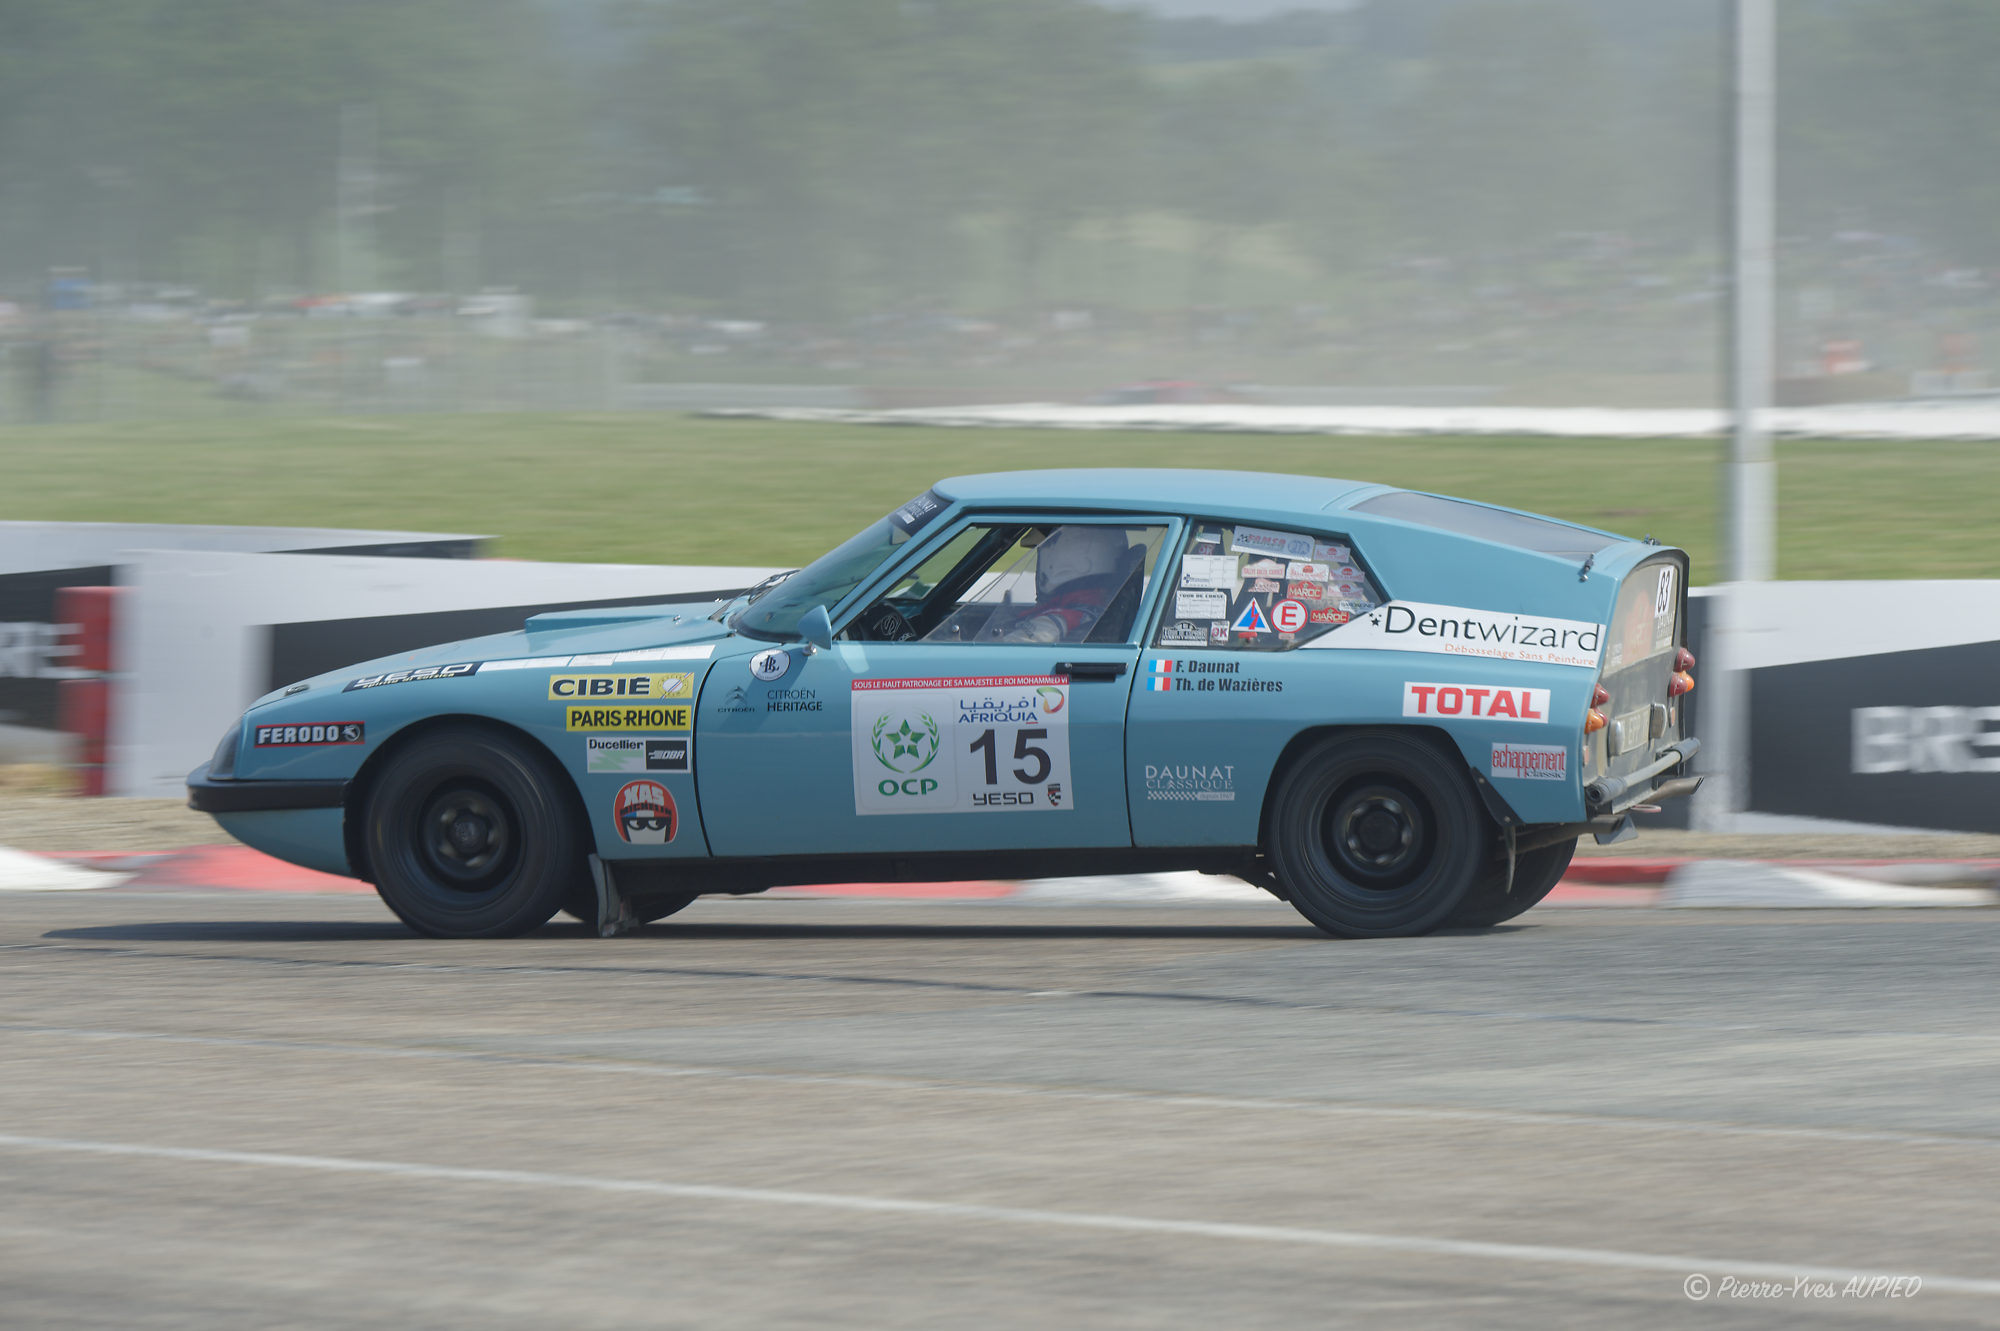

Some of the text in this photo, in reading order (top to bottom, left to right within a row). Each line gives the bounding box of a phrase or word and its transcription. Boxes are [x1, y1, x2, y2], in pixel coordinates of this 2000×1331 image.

[1289, 587, 1321, 597] MAROC
[1657, 570, 1670, 613] 83
[1281, 606, 1298, 626] E
[1312, 611, 1347, 620] MAROC
[1384, 605, 1600, 651] Dentwizard
[1519, 650, 1543, 661] Sans
[1548, 653, 1595, 666] Peinture
[1175, 660, 1240, 673] F. Daunat
[552, 676, 650, 696] CIBIÉ
[854, 681, 872, 689] SOUS
[882, 680, 900, 688] HAUT
[902, 679, 941, 688] PATRONAGE
[943, 679, 952, 687] DE
[954, 679, 962, 687] SA
[963, 678, 993, 686] MAJESTE
[1004, 677, 1016, 685] ROI
[1017, 677, 1060, 685] MOHAMMED
[1175, 678, 1283, 692] Th. de Wazières
[767, 687, 816, 700] CITROËN
[767, 701, 823, 712] HERITAGE
[1411, 686, 1541, 720] TOTAL
[958, 711, 1038, 723] AFRIQUIA
[258, 725, 340, 745] FERODO
[589, 739, 644, 750] Ducellier
[969, 728, 1052, 785] 15
[1145, 765, 1234, 780] DAUNAT
[878, 778, 938, 796] OCP
[1146, 780, 1233, 791] CLASSIQUE
[972, 792, 1034, 806] YESO
